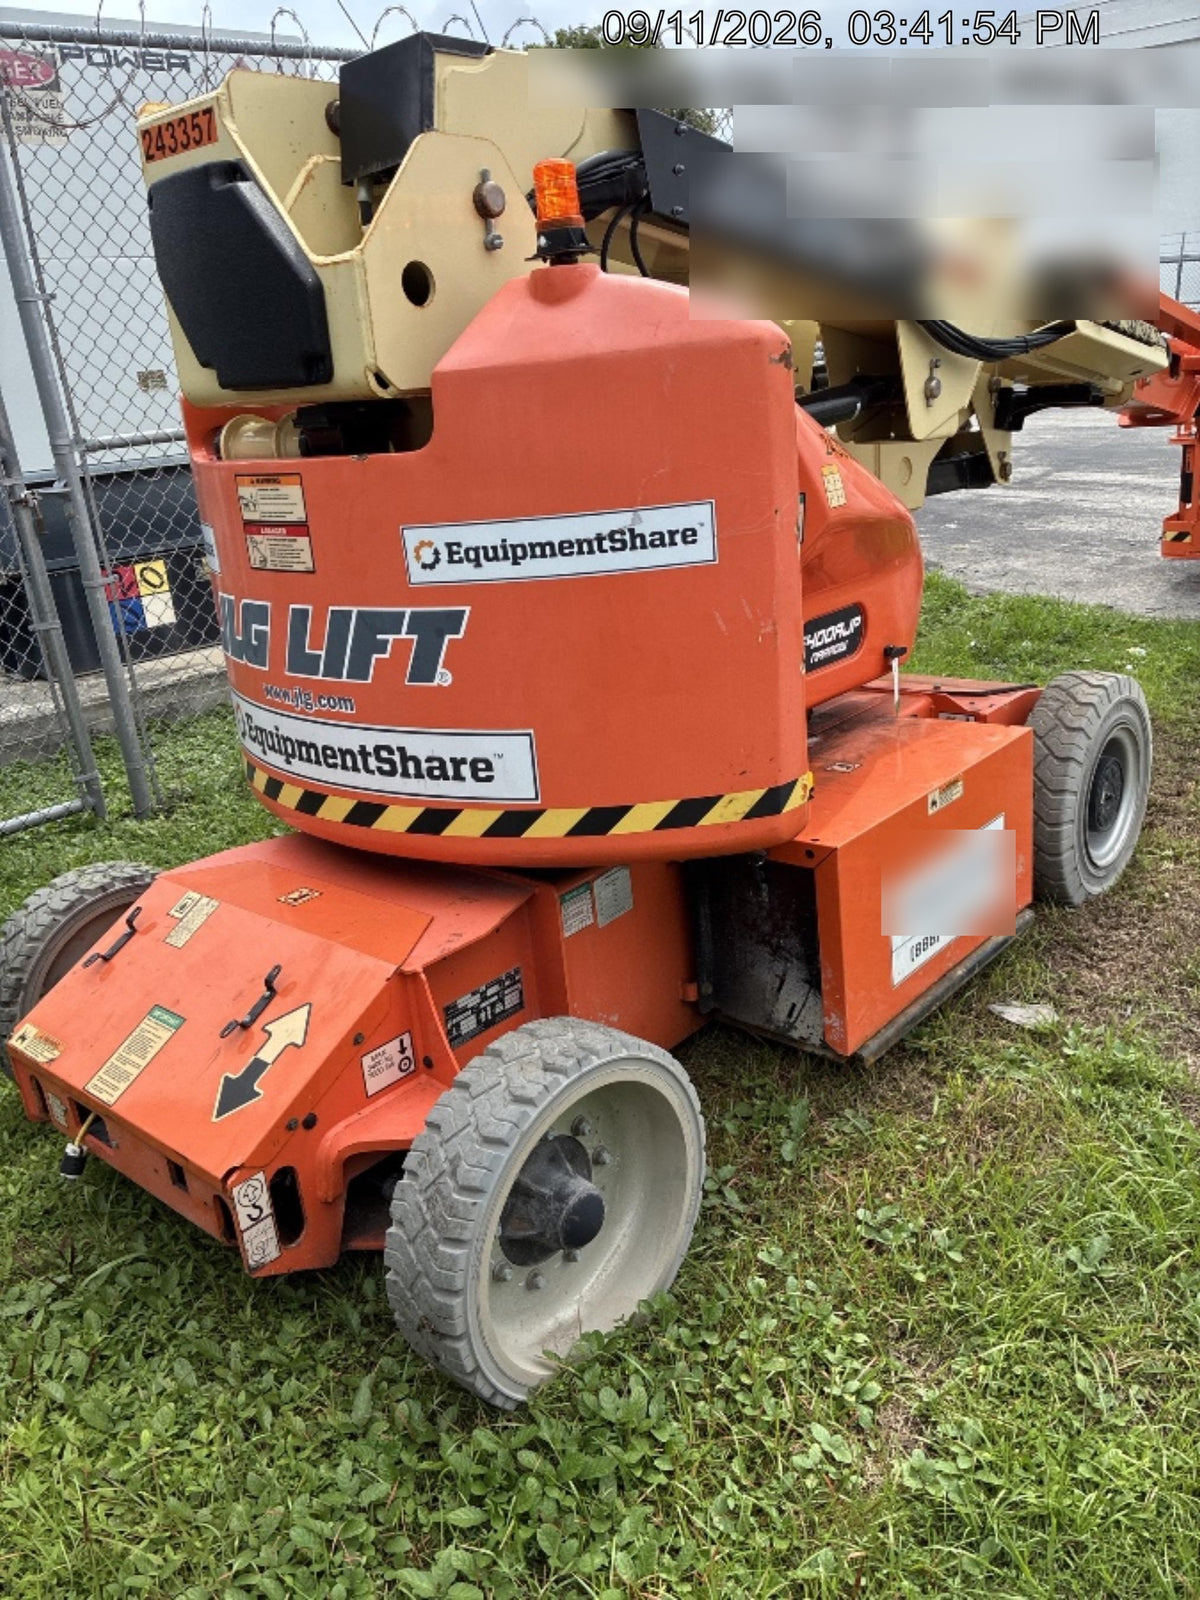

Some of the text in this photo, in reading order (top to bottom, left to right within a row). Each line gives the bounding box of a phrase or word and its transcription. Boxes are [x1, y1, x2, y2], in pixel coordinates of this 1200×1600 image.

[58, 44, 190, 73] POWER
[143, 106, 214, 161] 243357
[263, 682, 356, 713] www.jlg.com
